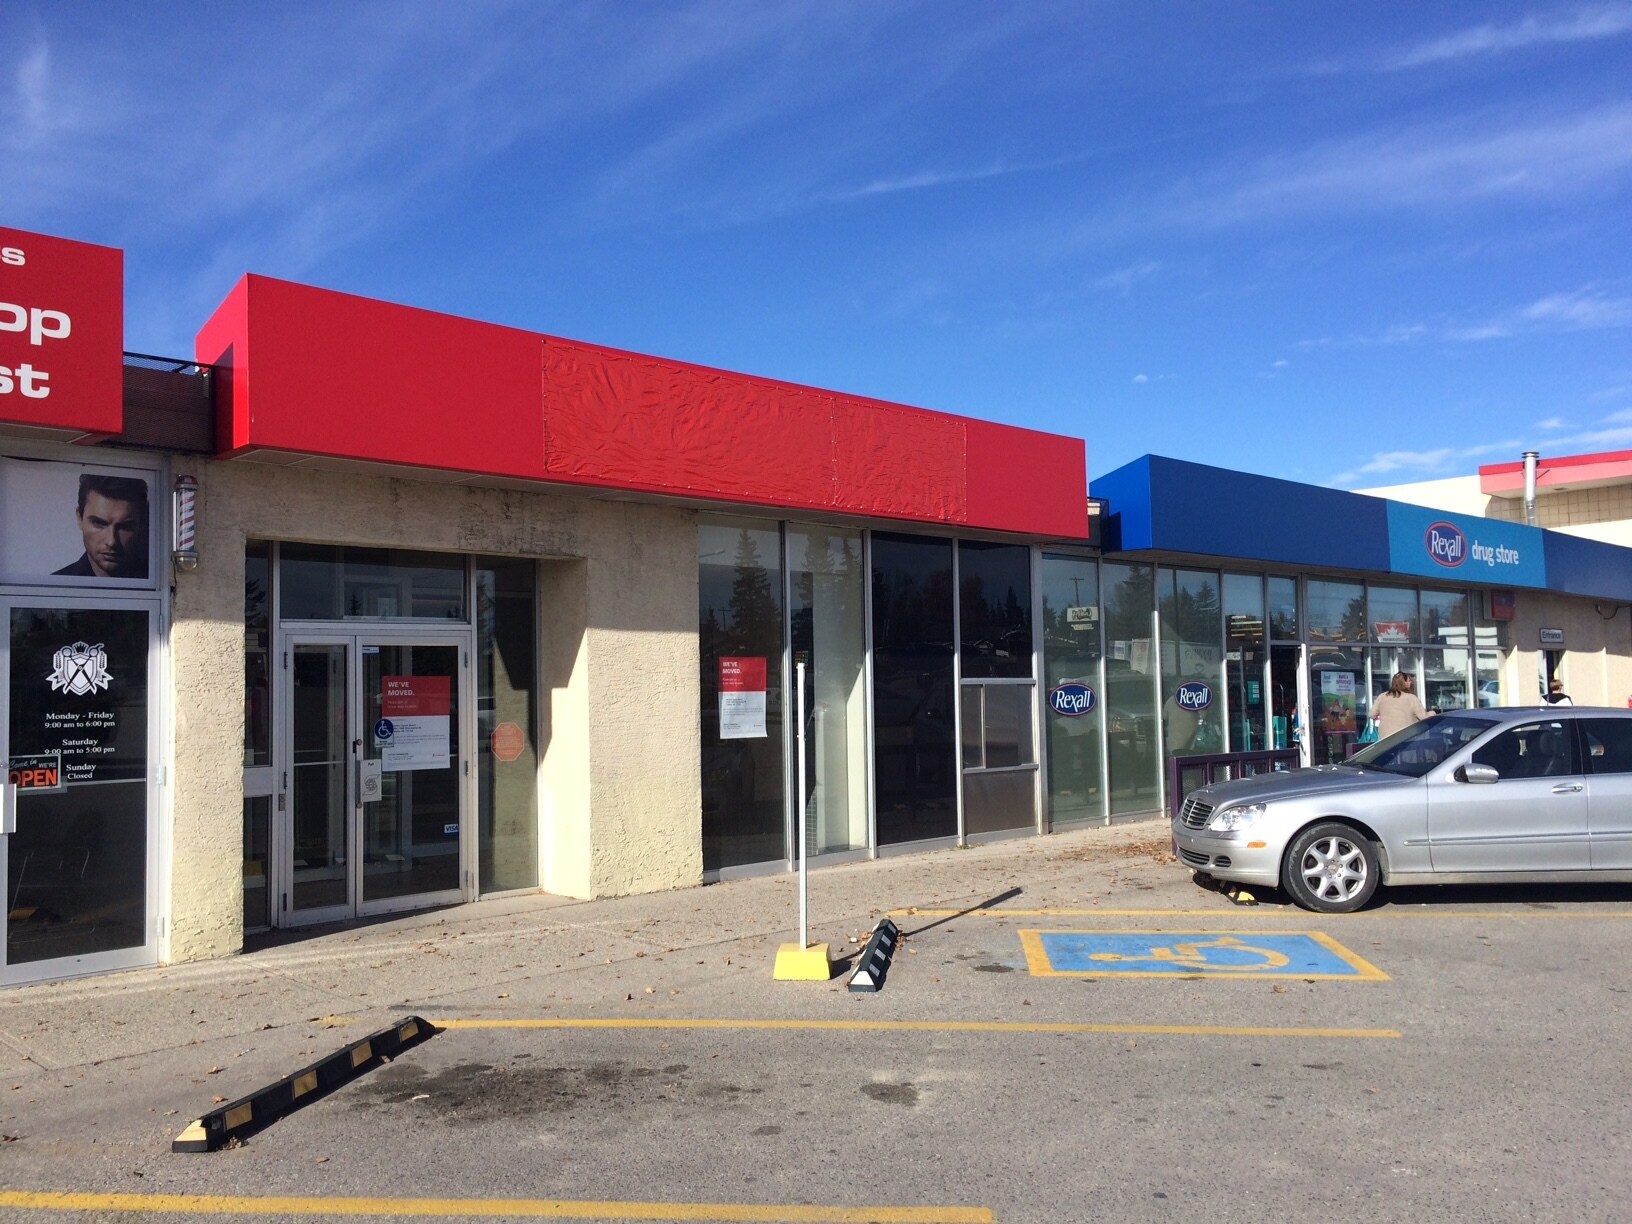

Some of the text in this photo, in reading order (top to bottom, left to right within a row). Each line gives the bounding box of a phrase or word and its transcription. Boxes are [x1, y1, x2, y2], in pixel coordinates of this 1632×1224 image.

[0, 247, 26, 266] s
[1431, 530, 1462, 562] Rexall
[1472, 540, 1519, 567] drug store
[1542, 630, 1562, 639] Entrance
[1055, 690, 1091, 713] Rexall
[1179, 686, 1208, 708] Rexall
[46, 712, 80, 720] Monday
[88, 711, 115, 720] Friday
[62, 738, 98, 746] Saturday
[65, 763, 97, 772] Sunday
[67, 772, 93, 780] Closed
[9, 769, 57, 787] OPEN
